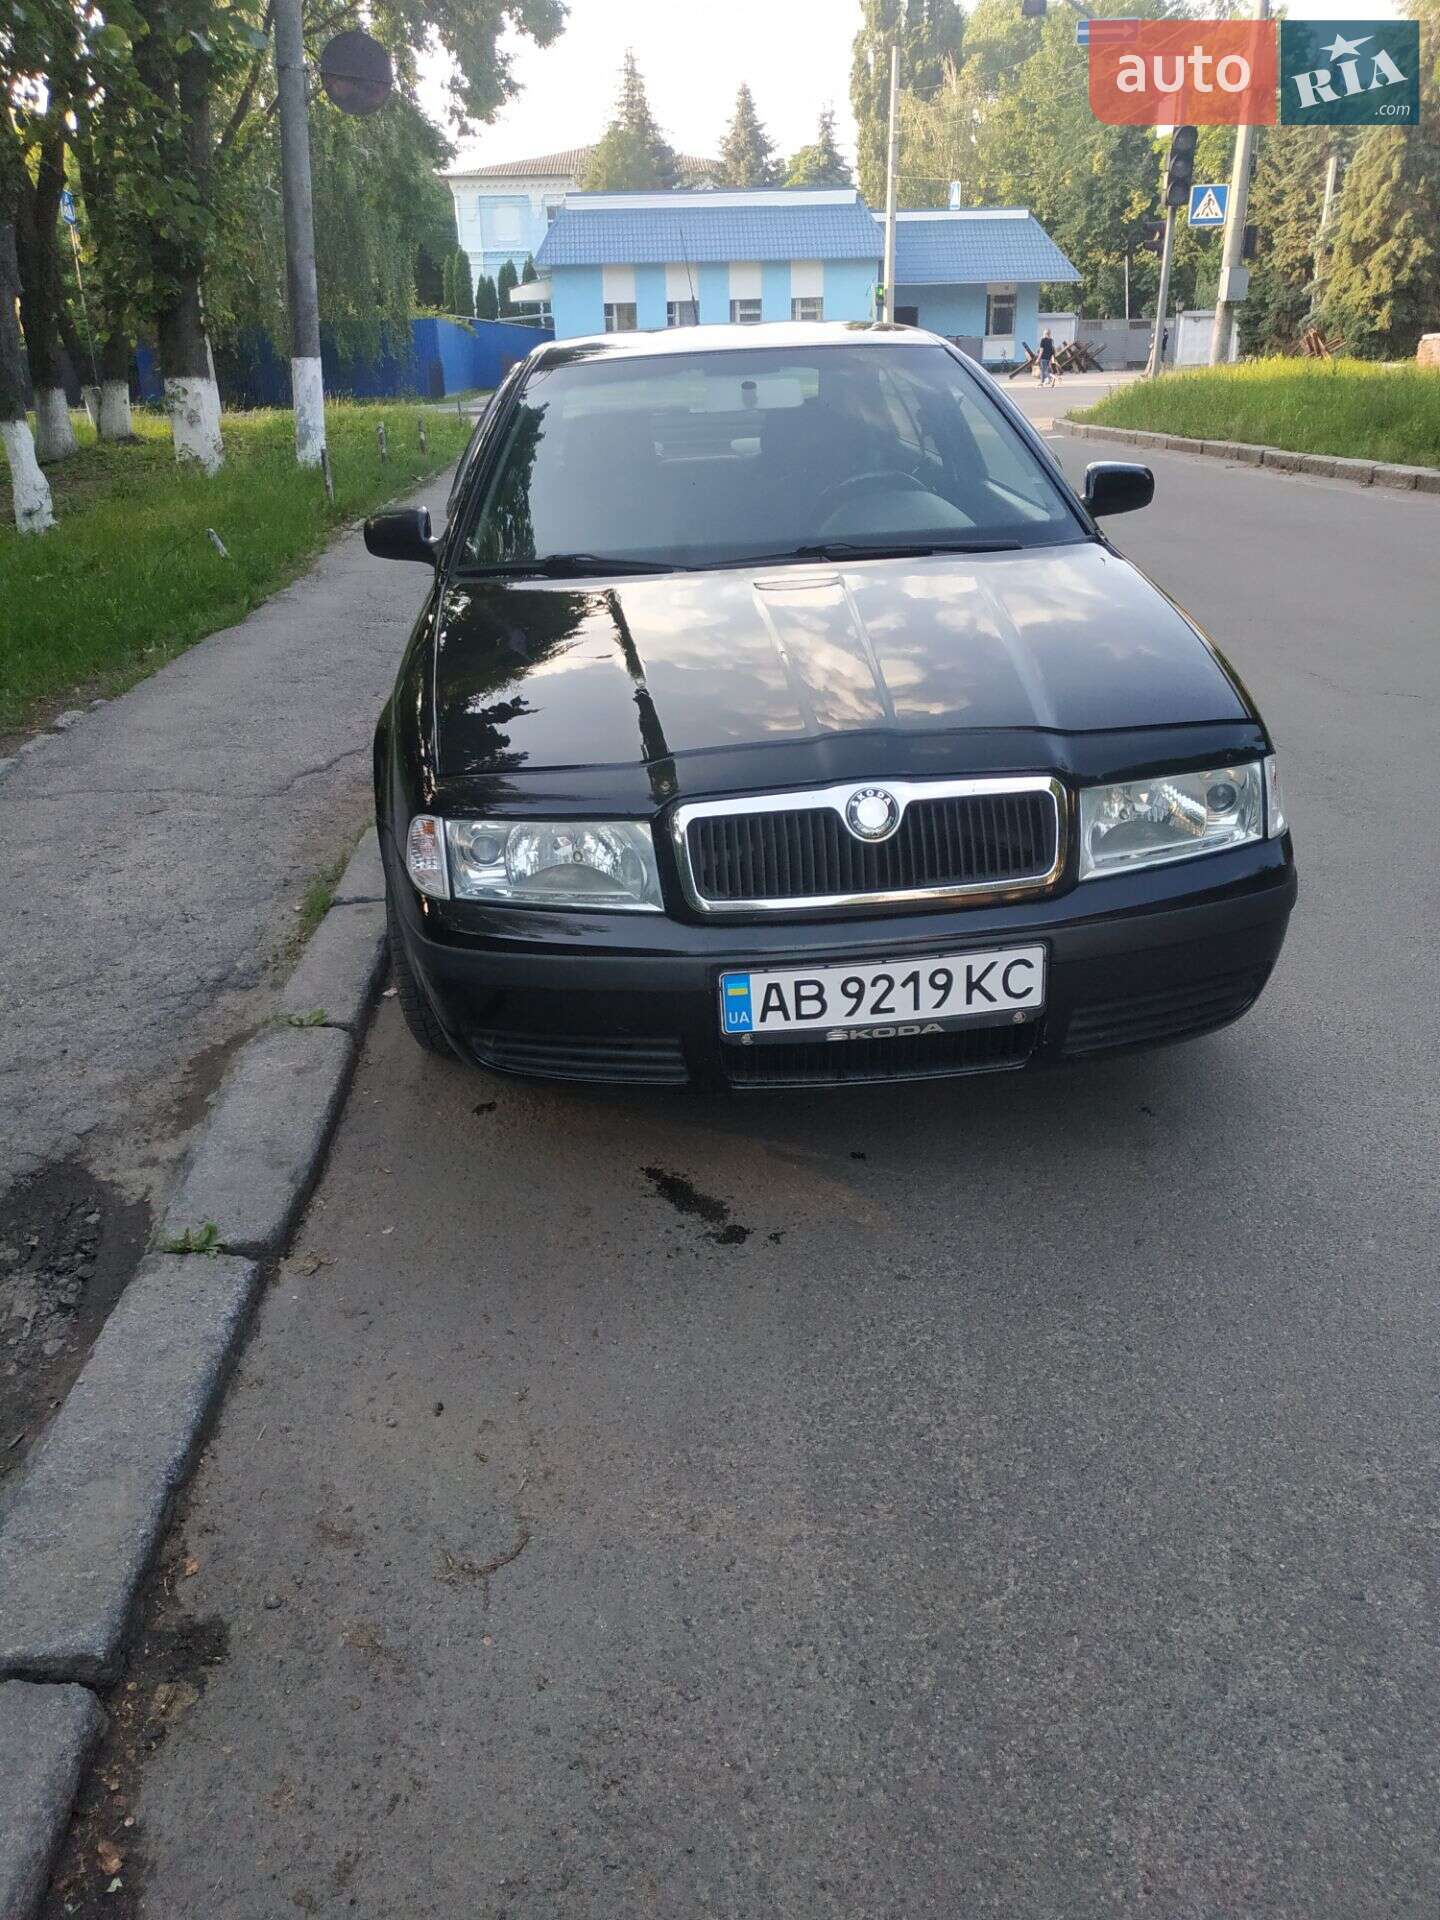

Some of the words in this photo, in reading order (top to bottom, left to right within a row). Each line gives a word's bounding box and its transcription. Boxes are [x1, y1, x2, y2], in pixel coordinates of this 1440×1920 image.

[759, 979, 828, 1023] AB
[840, 967, 953, 1017] 9219
[965, 957, 1034, 1005] KC
[729, 1011, 750, 1025] UA
